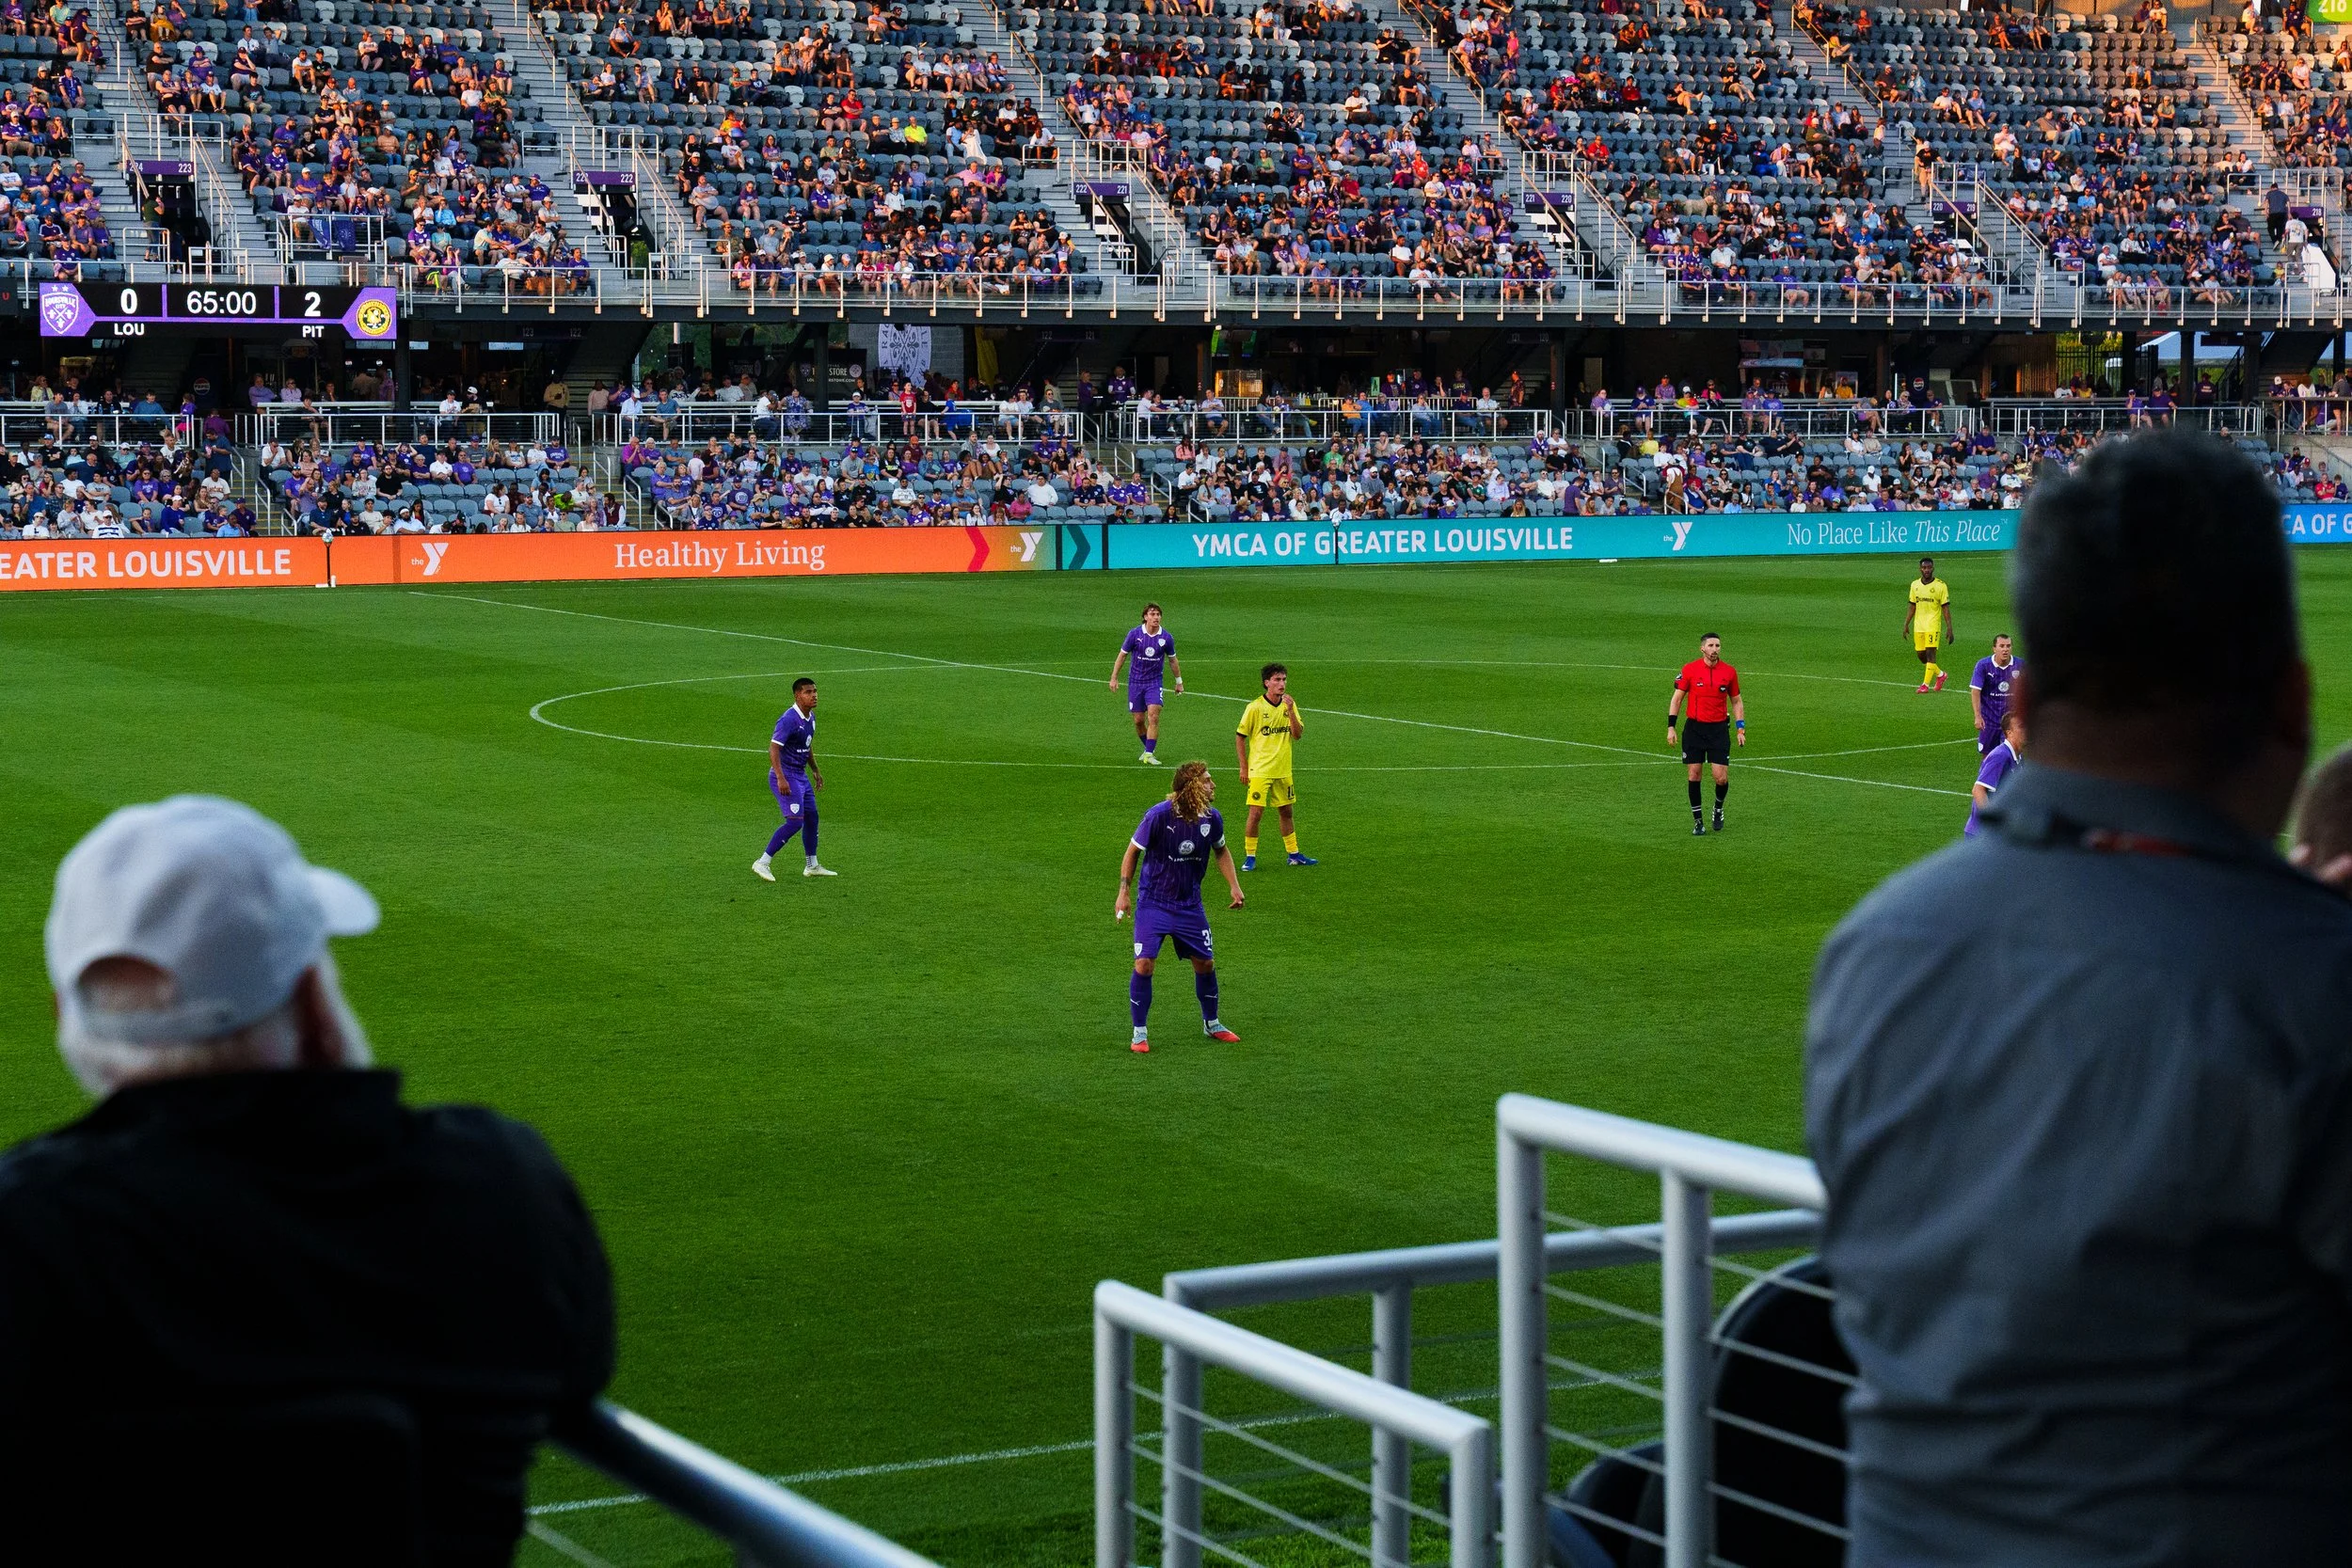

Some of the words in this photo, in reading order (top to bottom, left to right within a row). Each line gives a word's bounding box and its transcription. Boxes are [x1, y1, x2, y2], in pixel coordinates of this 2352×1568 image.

[178, 163, 192, 173] 223
[620, 174, 633, 183] 222
[1075, 184, 1088, 194] 222
[1117, 185, 1128, 195] 221
[1525, 194, 1535, 202] 221
[1562, 195, 1572, 203] 220
[1932, 202, 1944, 212] 220
[120, 288, 138, 314] 0
[186, 290, 257, 314] 65:00
[304, 291, 322, 317] 2
[114, 323, 145, 336] LOU
[302, 325, 325, 338] PIT
[828, 367, 848, 376] STORE
[2312, 514, 2337, 535] OF
[1788, 523, 1812, 546] No
[1818, 521, 1863, 546] Place
[1868, 520, 1908, 544] Like
[1915, 519, 1950, 543] This
[1009, 545, 1022, 553] the
[1192, 533, 1267, 558] YMCA
[1274, 532, 1308, 557] OF
[1314, 530, 1427, 555] GREATER
[1433, 527, 1573, 553] LOUISVILLE
[108, 548, 291, 578] LOUISVILLE
[411, 557, 424, 565] the
[614, 541, 727, 573] Healthy
[736, 540, 826, 571] Living
